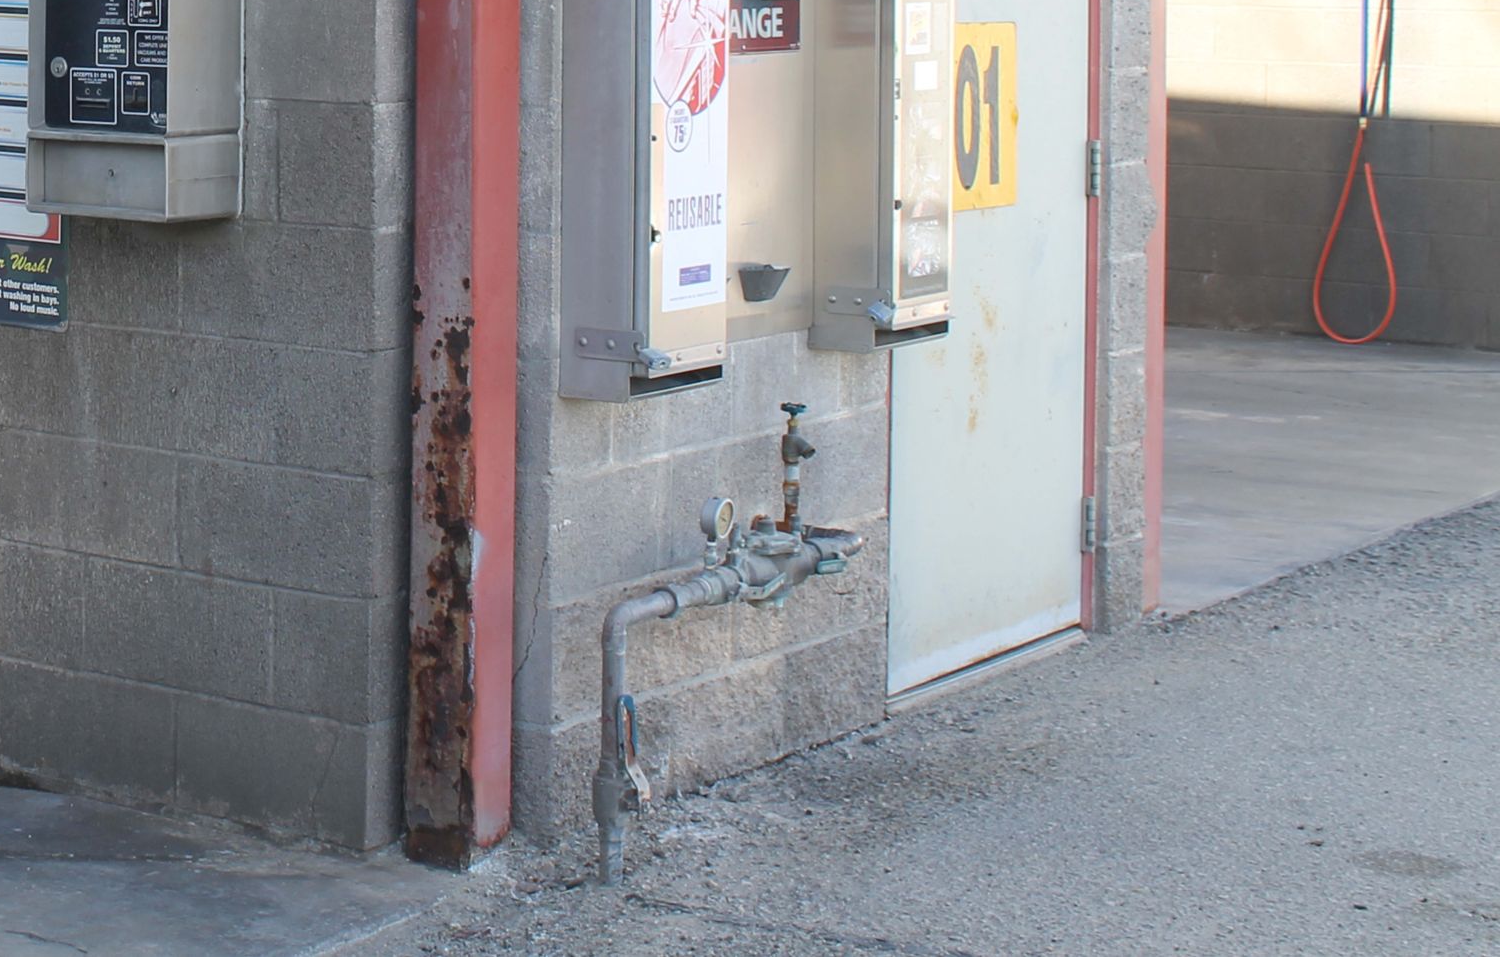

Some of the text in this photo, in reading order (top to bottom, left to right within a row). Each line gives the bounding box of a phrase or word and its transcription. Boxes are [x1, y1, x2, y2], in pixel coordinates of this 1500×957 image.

[728, 7, 784, 39] ANGE
[954, 44, 999, 190] 01
[668, 193, 721, 231] REUSABLE
[9, 254, 53, 274] Wash!
[3, 278, 20, 289] other
[22, 281, 59, 294] customers.
[3, 290, 31, 304] washing
[32, 293, 39, 303] in
[41, 294, 59, 306] bays.
[10, 302, 59, 316] No loud music.
